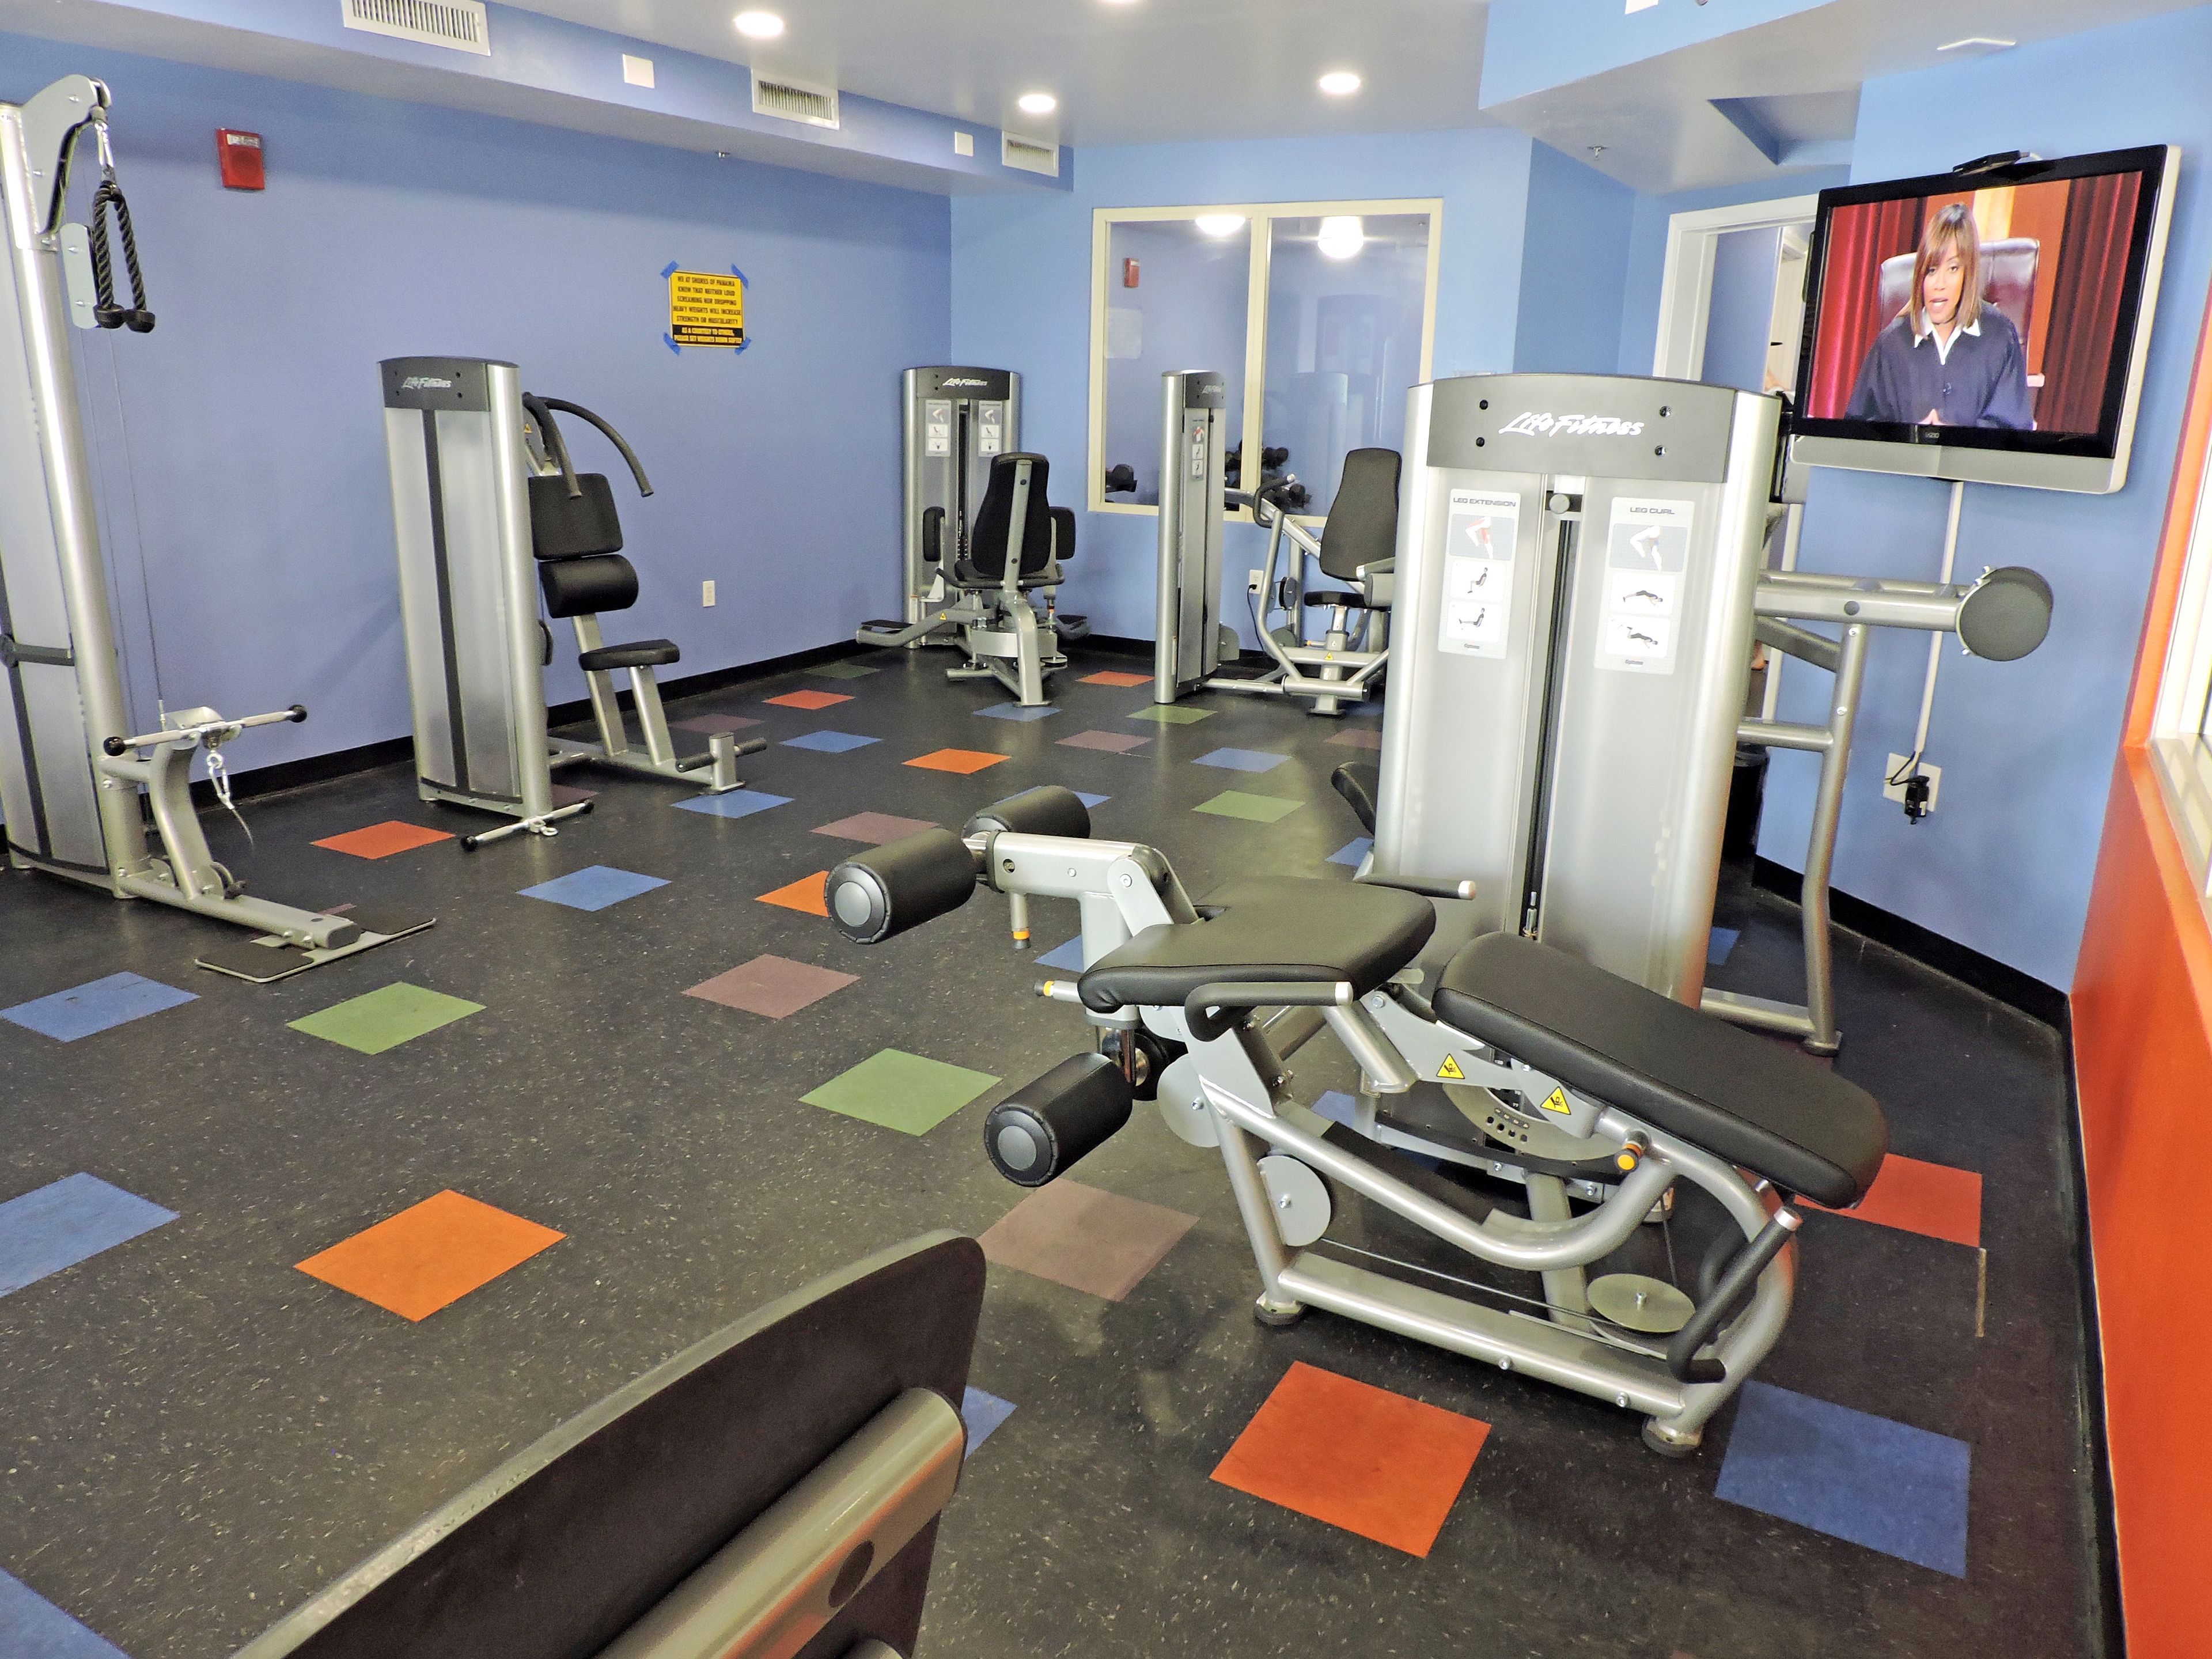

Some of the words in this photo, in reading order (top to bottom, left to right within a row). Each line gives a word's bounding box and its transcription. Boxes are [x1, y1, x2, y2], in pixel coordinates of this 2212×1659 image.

[1498, 411, 1554, 437] Life
[1548, 414, 1645, 438] Fitness
[1469, 498, 1516, 507] EXTENSION
